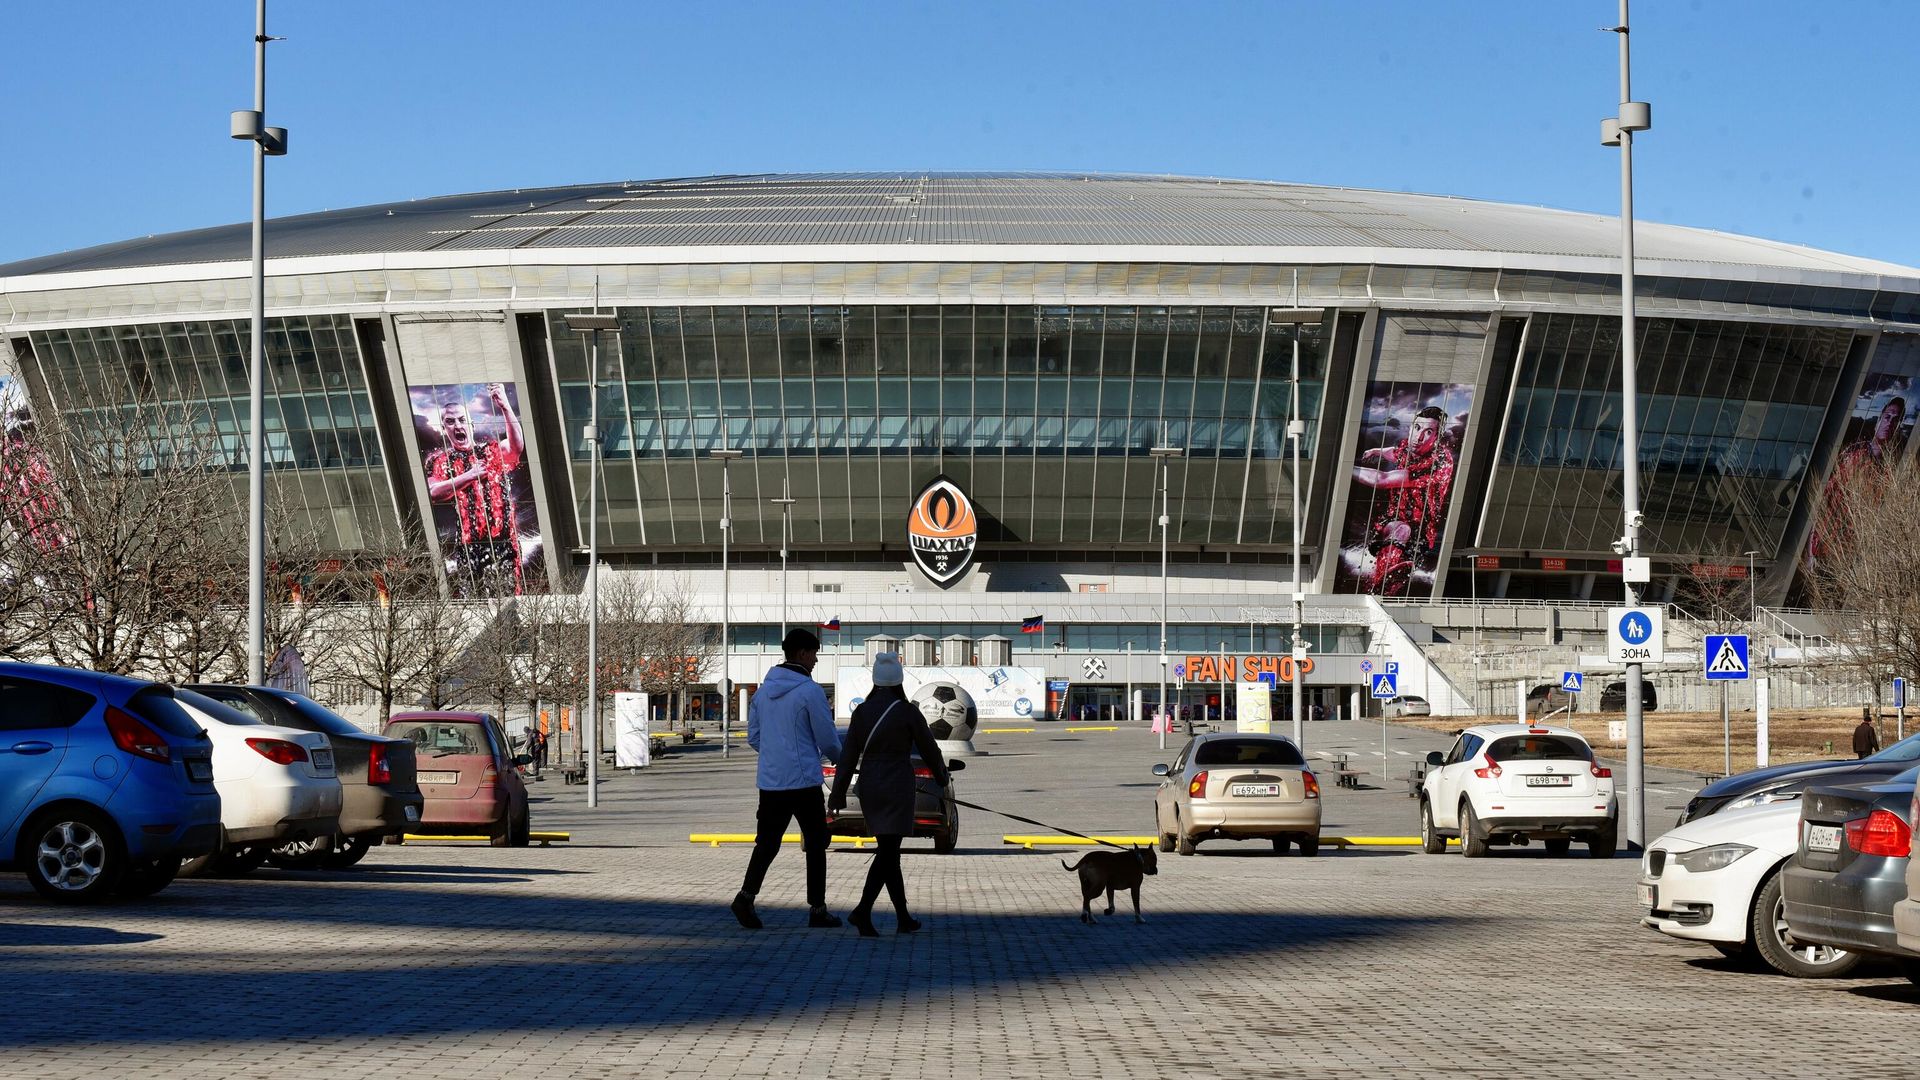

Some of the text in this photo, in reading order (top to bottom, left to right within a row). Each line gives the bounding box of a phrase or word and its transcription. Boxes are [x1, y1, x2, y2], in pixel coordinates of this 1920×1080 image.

[912, 535, 975, 552] ШАХТАР
[1621, 648, 1651, 659] ЗОНА
[1186, 655, 1315, 682] FAN SHOP
[1388, 663, 1396, 674] P
